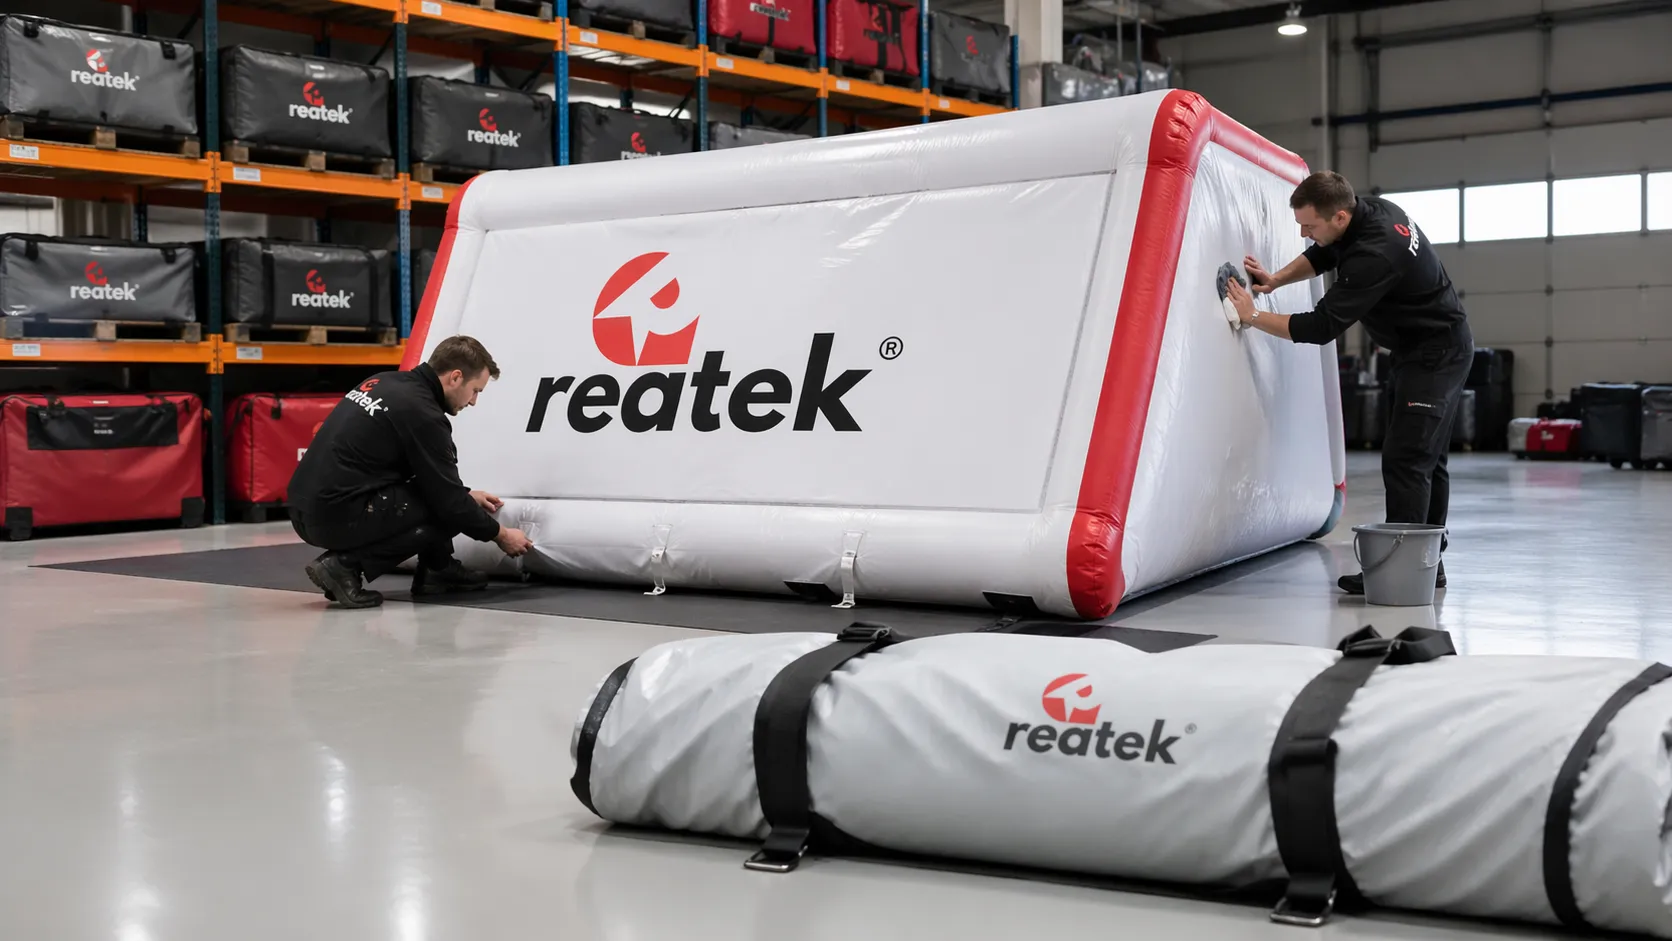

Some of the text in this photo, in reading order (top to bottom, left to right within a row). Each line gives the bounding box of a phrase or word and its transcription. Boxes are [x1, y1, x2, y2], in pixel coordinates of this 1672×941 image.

[71, 67, 136, 91] reatek
[289, 104, 350, 125] reatek
[467, 129, 520, 148] reatek
[70, 282, 136, 301] reatek
[291, 290, 351, 309] reatek
[525, 332, 873, 433] reatek
[1003, 719, 1182, 765] reatek
